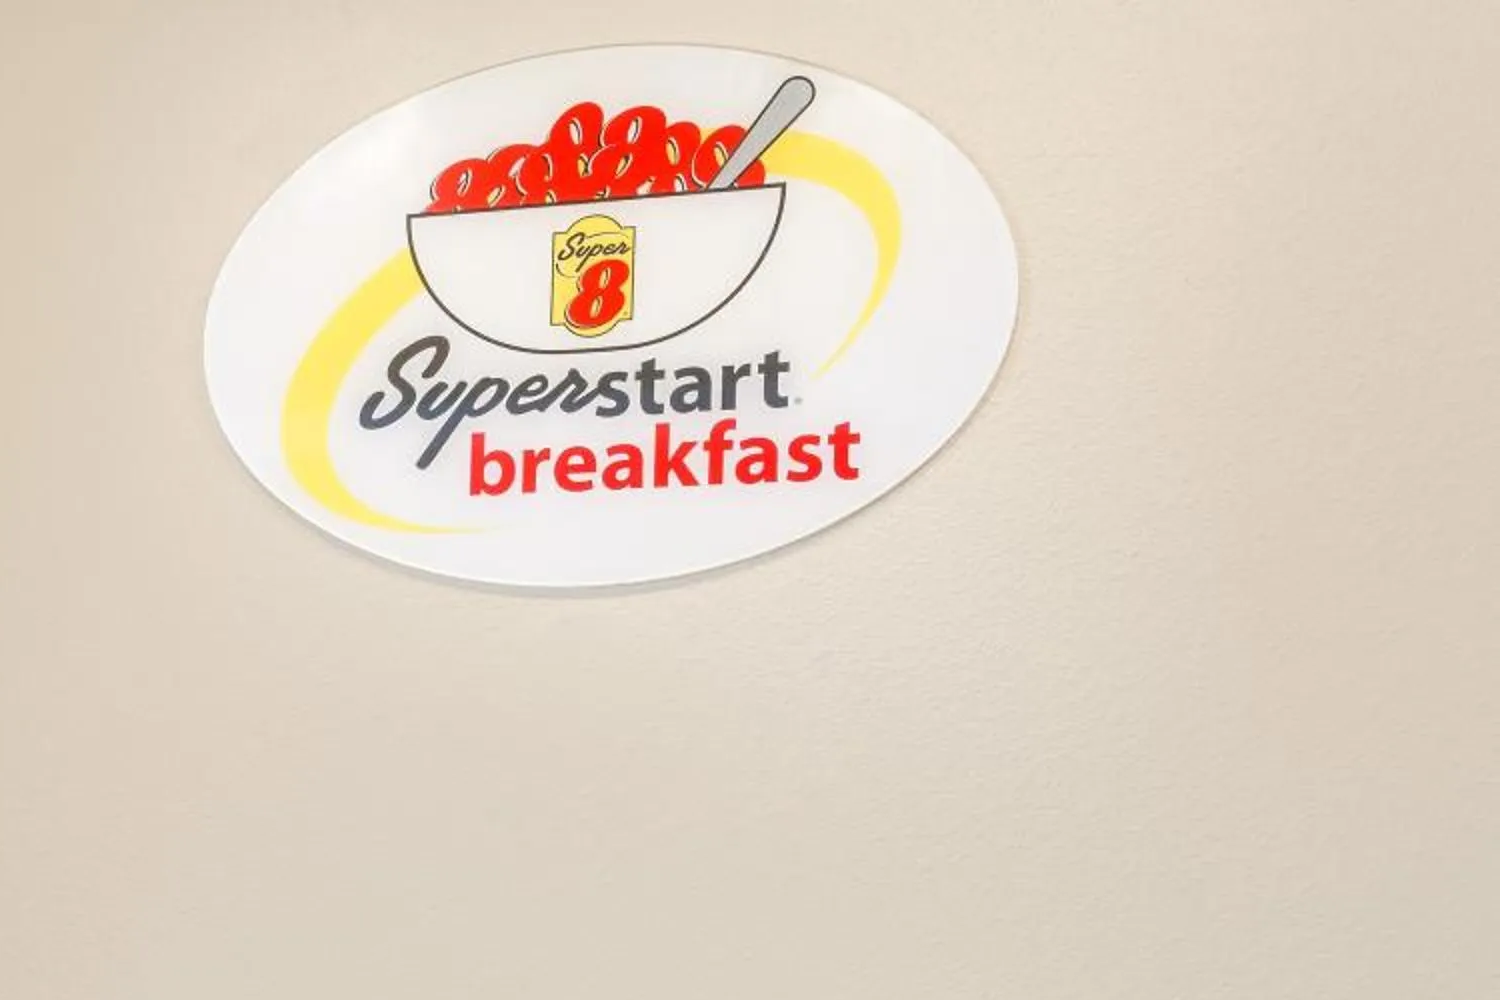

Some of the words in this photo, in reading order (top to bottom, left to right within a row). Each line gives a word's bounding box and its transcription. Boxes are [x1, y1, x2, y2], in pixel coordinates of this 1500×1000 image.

[558, 232, 631, 273] Super
[564, 258, 629, 329] 8
[358, 336, 791, 470] Superstart
[469, 420, 862, 496] breakfast
